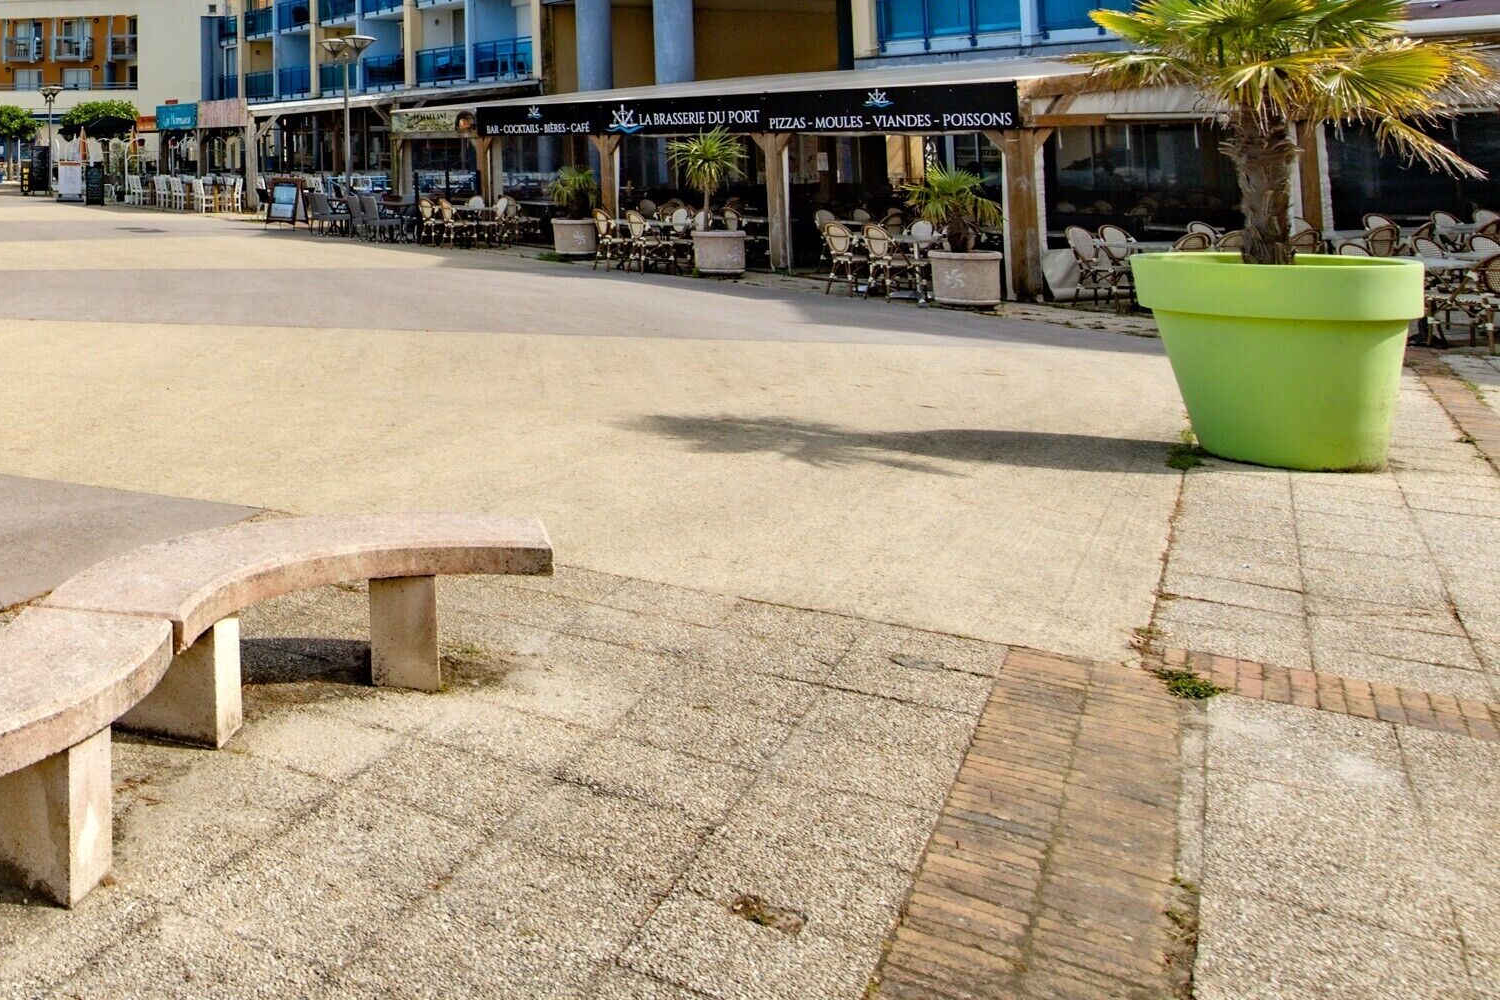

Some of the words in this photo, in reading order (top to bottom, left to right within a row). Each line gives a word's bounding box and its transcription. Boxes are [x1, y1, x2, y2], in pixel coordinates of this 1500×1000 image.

[639, 113, 652, 126] LA
[653, 111, 706, 126] BRASSERIE
[708, 111, 725, 125] DU
[728, 110, 760, 124] PORT
[769, 117, 806, 129] PIZZAS
[815, 116, 863, 129] MOULES
[872, 114, 931, 128] VIANDES
[943, 112, 1013, 126] POISSONS
[486, 125, 499, 134] BAR
[503, 124, 539, 134] COCKTAILS
[544, 122, 566, 133] BIÈRES
[571, 121, 590, 133] CAFÉ
